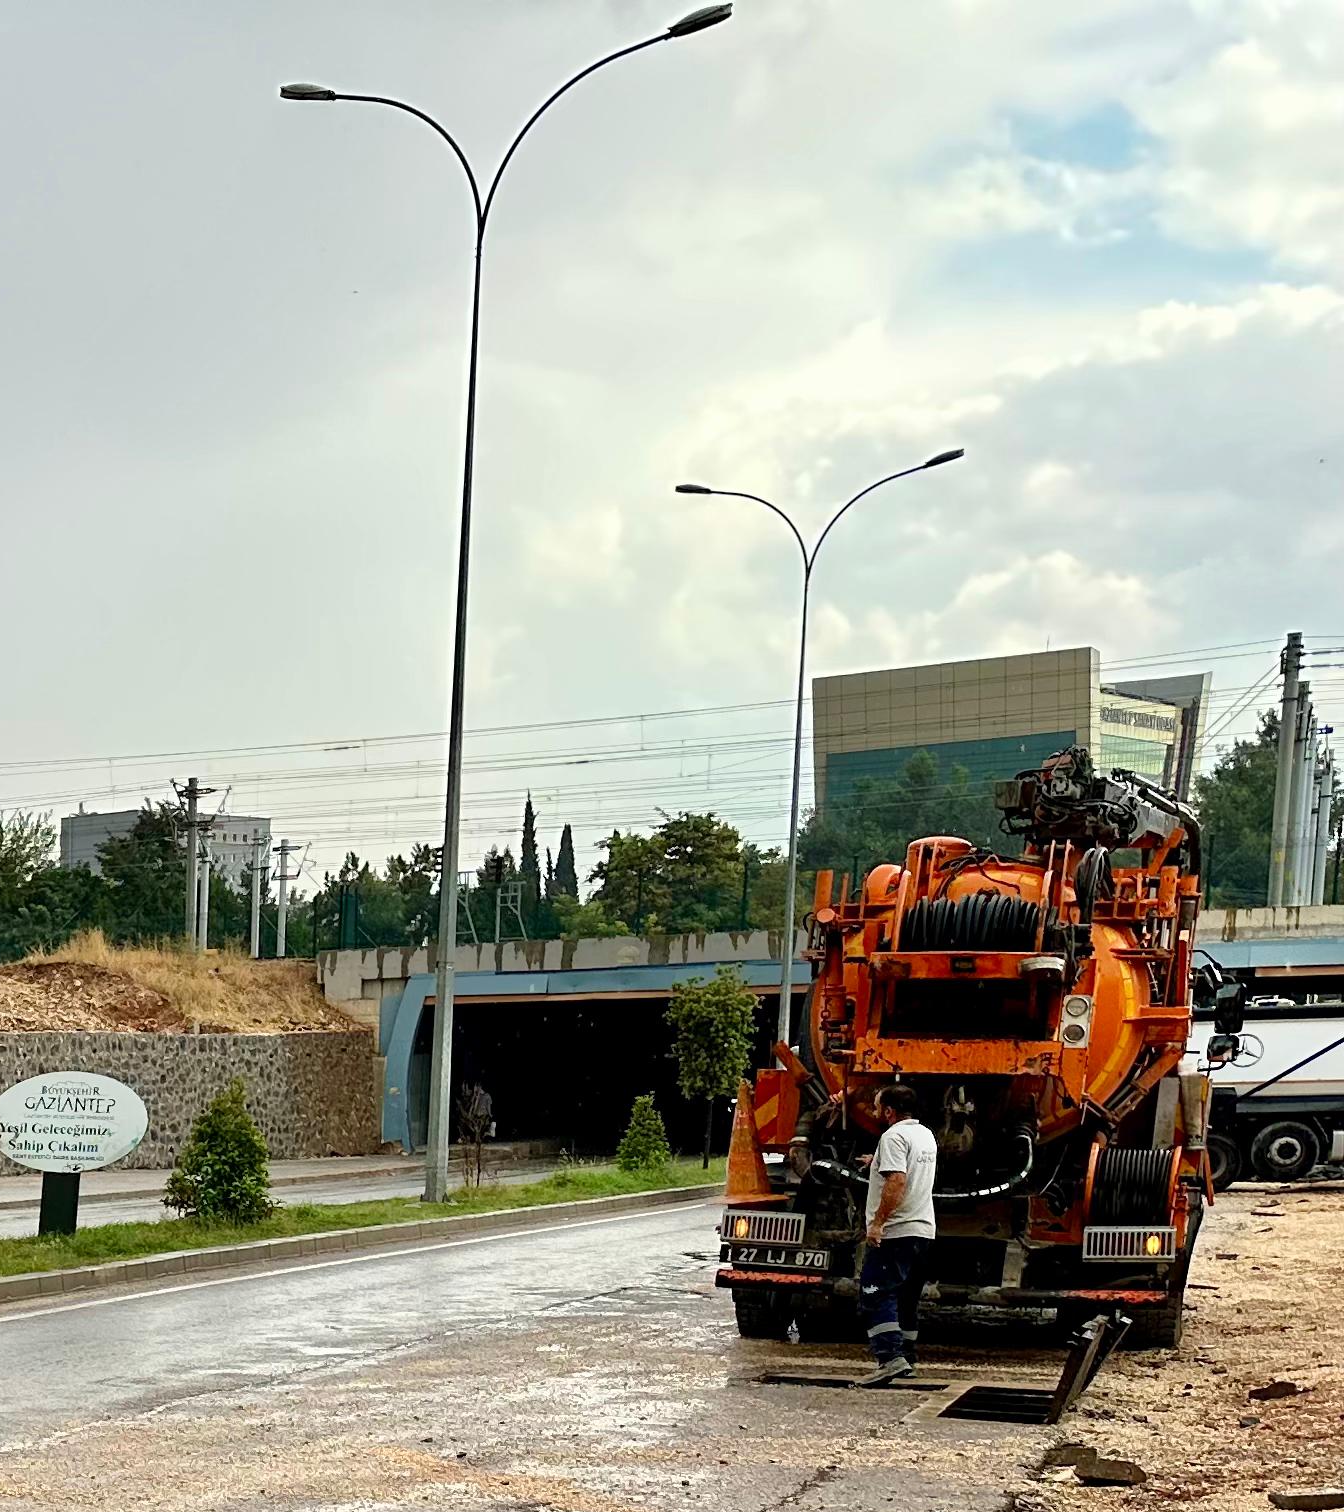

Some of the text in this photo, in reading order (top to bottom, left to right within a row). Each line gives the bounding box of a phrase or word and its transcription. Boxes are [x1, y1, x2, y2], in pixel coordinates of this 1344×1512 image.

[24, 1095, 116, 1113] GAZİANTEP
[0, 1122, 27, 1136] Yeşil
[8, 1139, 98, 1153] Sahip Çıkalım
[738, 1247, 823, 1267] 27 LJ 870
